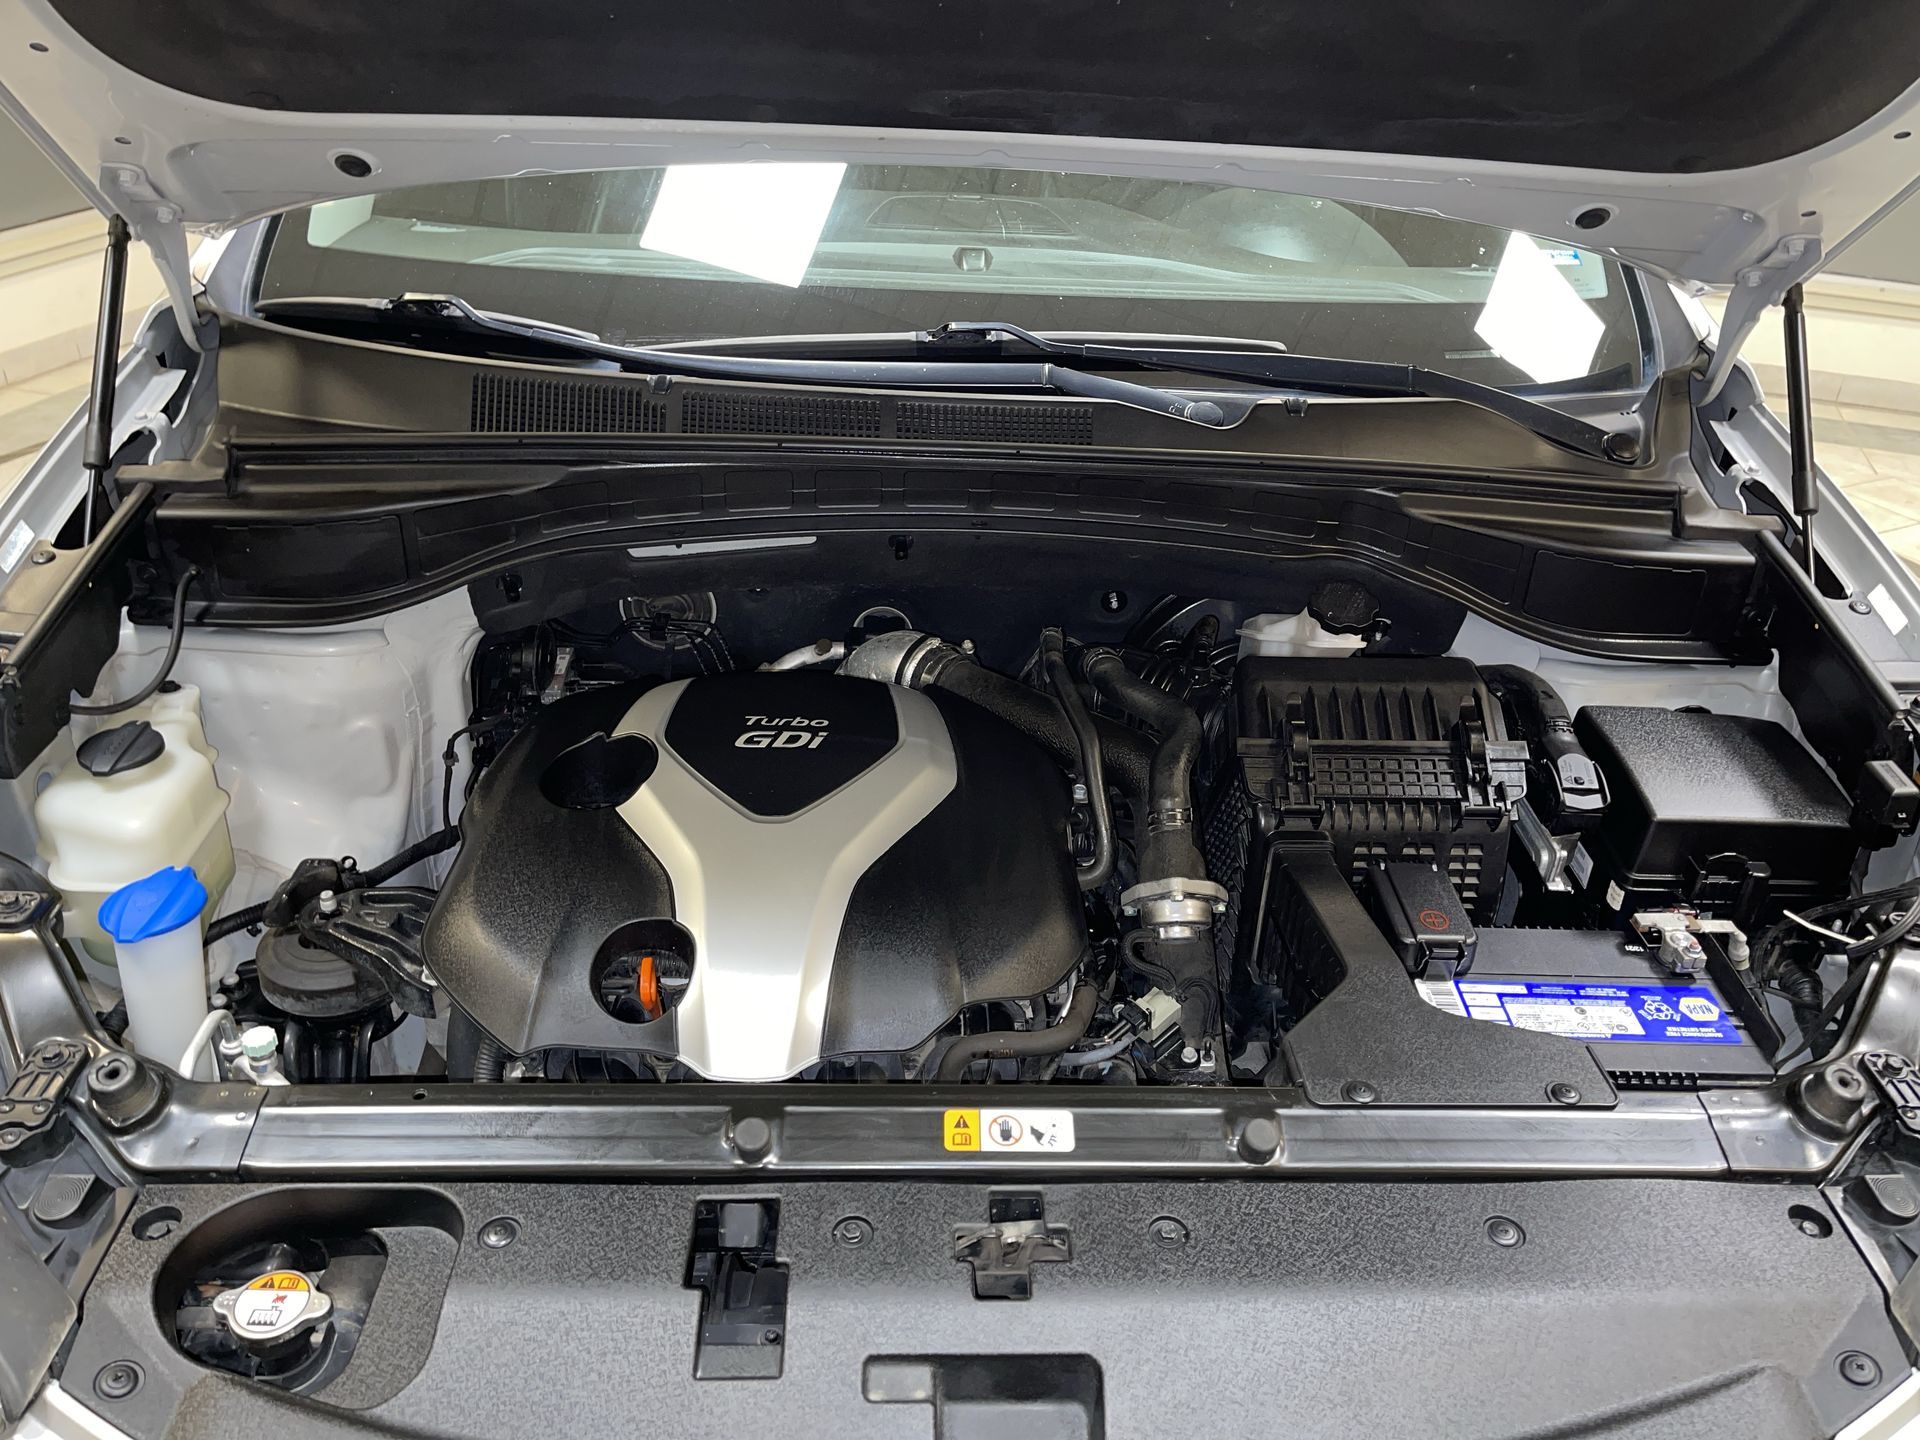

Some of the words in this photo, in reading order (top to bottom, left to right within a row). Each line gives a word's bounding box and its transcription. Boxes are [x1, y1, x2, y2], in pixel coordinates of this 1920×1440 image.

[745, 715, 829, 727] Turbo
[734, 730, 829, 748] GDi
[1684, 1003, 1714, 1015] NAPA
